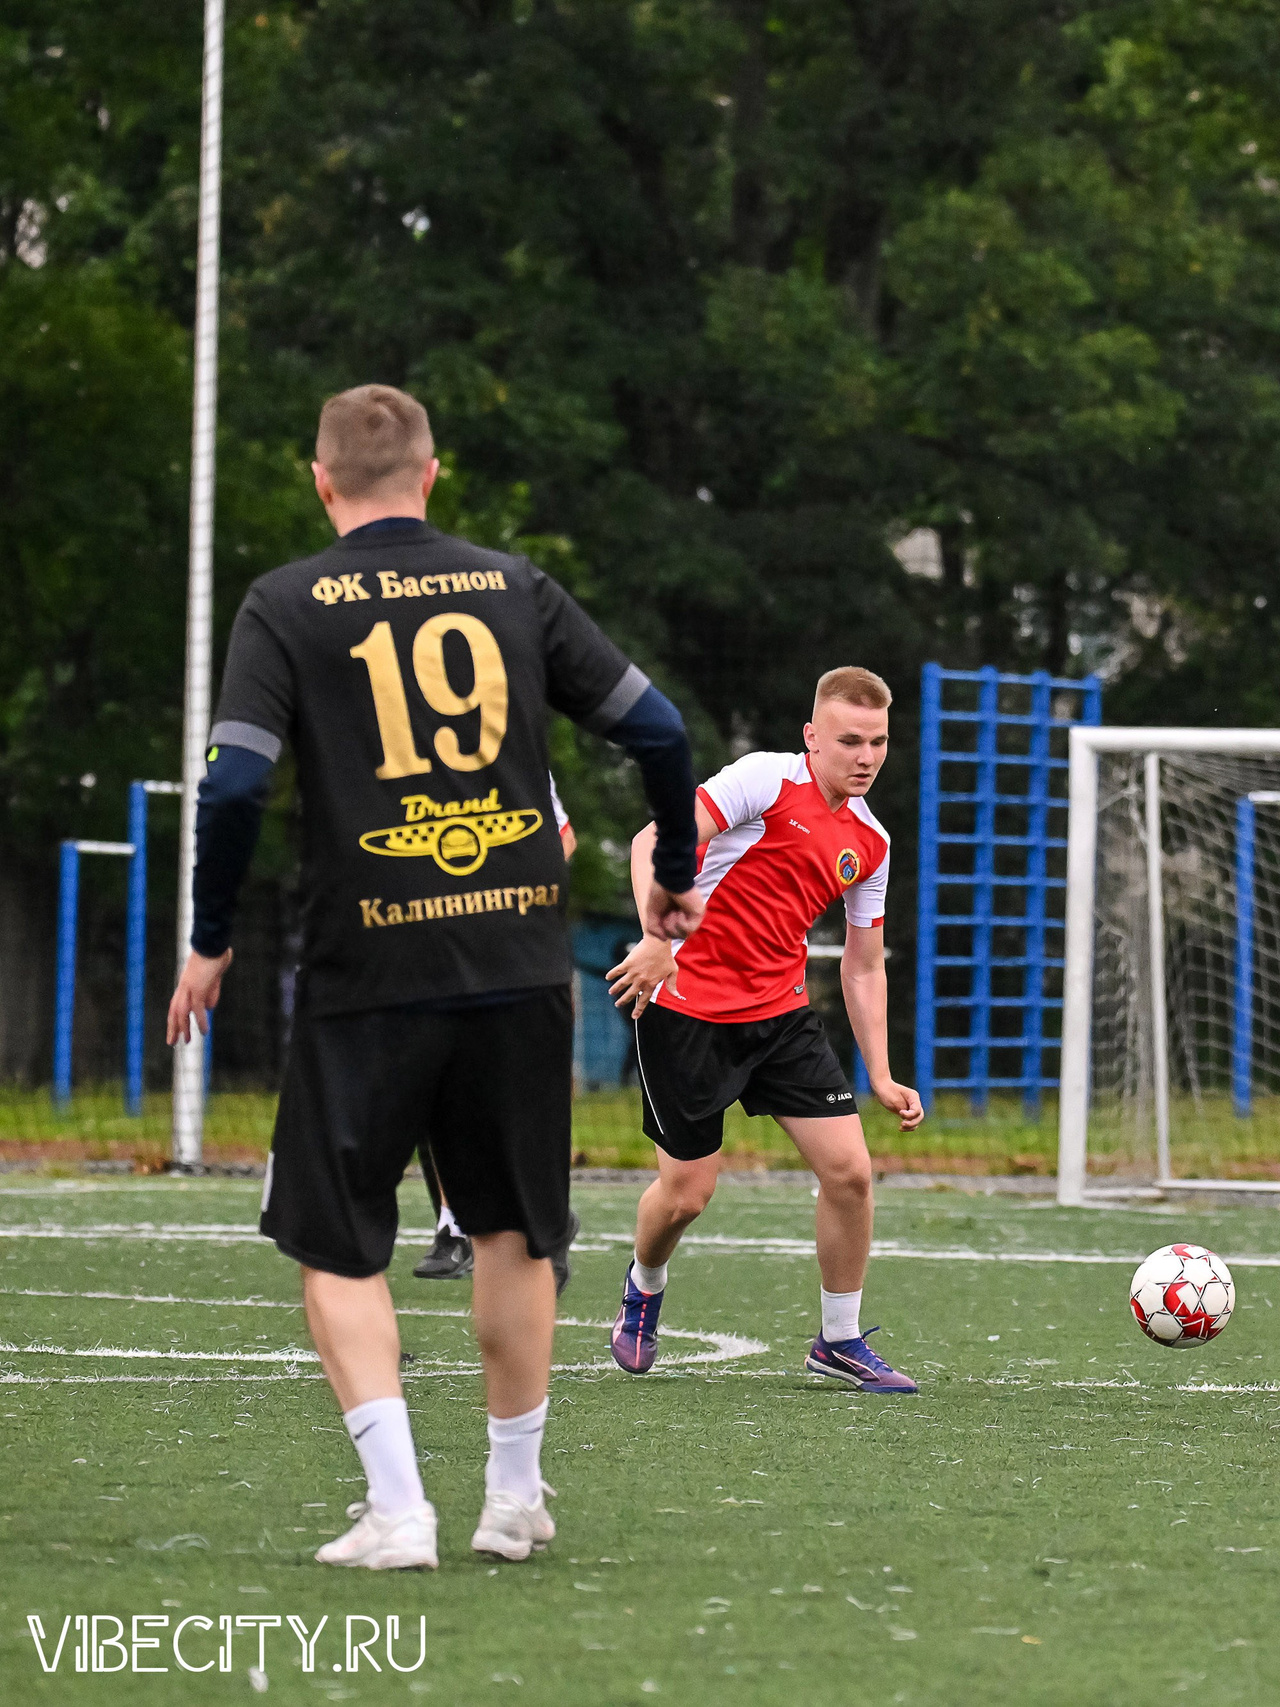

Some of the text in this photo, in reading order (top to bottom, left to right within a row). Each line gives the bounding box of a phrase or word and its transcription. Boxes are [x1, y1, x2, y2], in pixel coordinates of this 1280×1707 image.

[311, 570, 507, 606] ФК Бастион
[350, 612, 509, 780] 19
[401, 788, 502, 822] Brand
